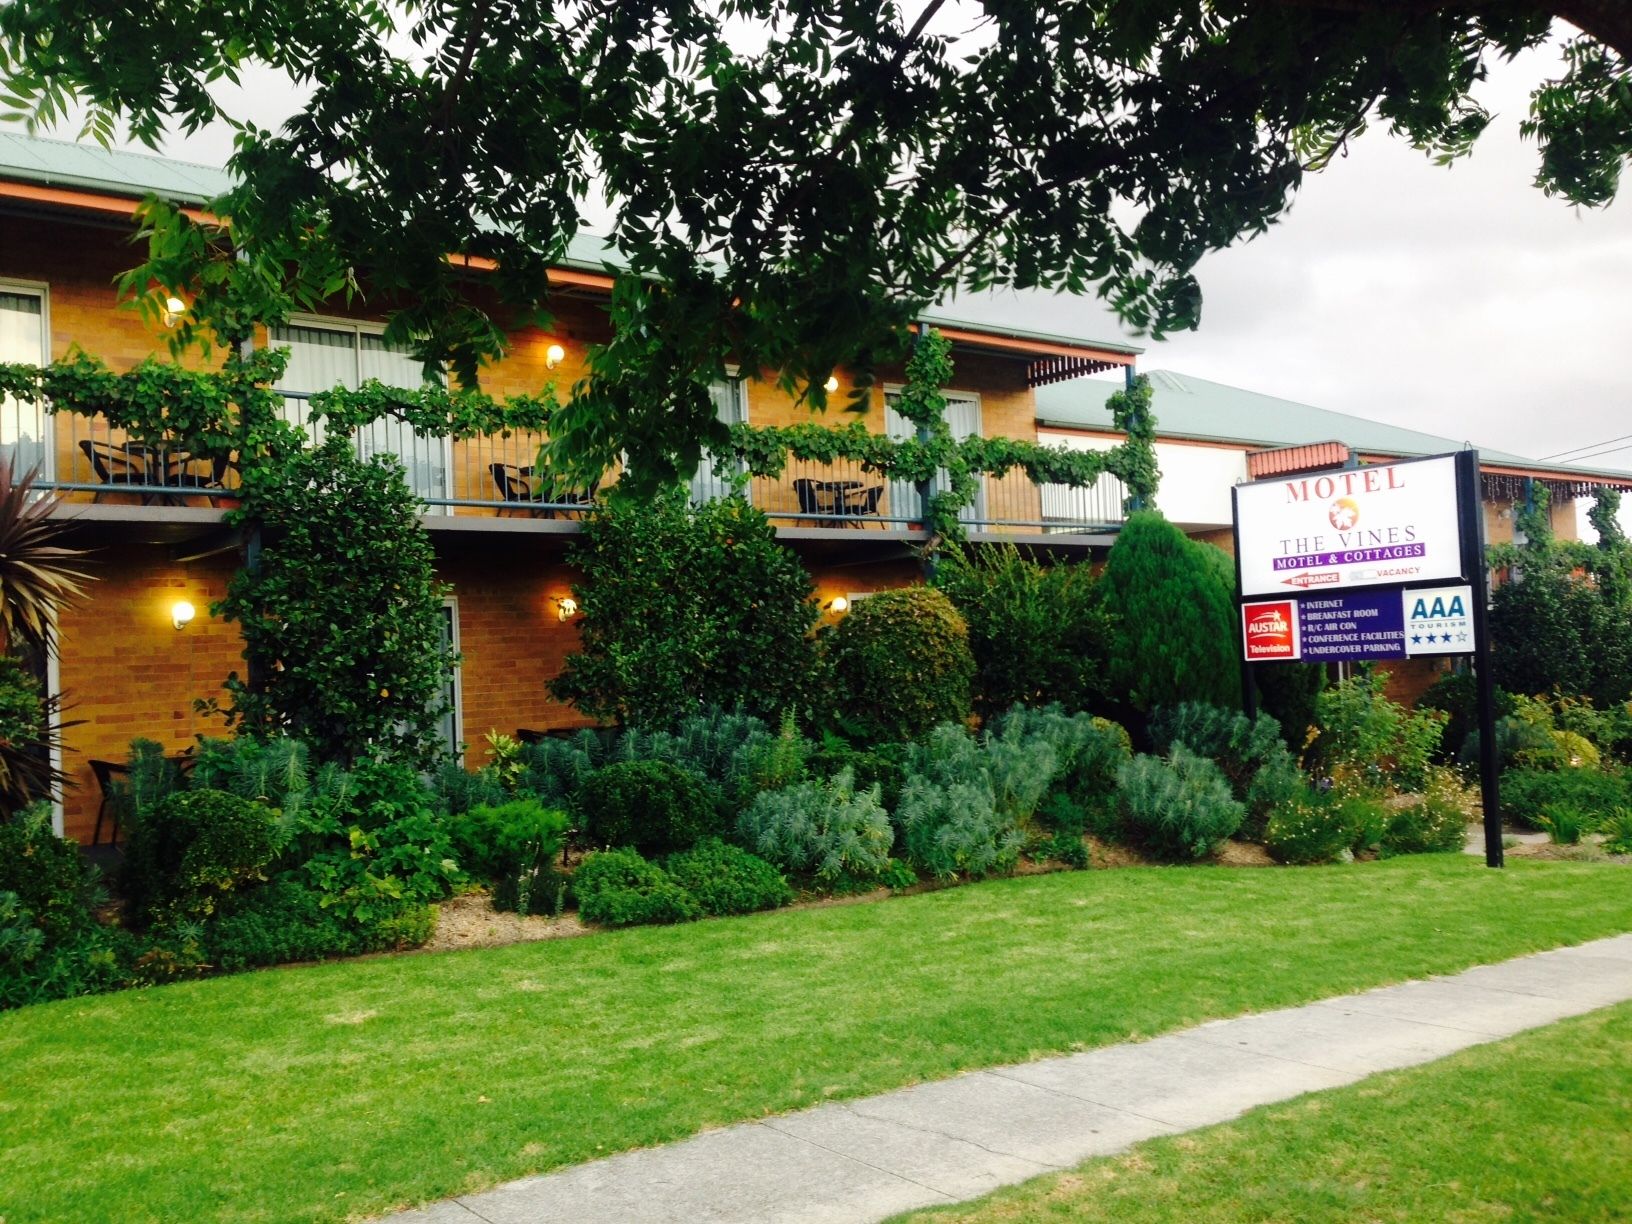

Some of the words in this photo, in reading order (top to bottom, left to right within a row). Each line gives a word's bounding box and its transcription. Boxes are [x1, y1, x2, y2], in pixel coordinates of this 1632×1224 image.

[1285, 467, 1405, 503] MOTEL
[1280, 536, 1325, 554] THE
[1339, 525, 1416, 548] VINES
[1277, 556, 1323, 569] MOTEL
[1328, 553, 1338, 564] &
[1344, 545, 1422, 562] COTTAGES
[1376, 566, 1420, 577] VACANCY
[1291, 573, 1338, 585] ENTRANCE
[1306, 600, 1343, 609] INTERNET
[1411, 595, 1465, 619] AAA
[1307, 610, 1351, 620] BREAKFAST
[1353, 608, 1378, 618] ROOM
[1248, 621, 1288, 633] AUSTAR
[1324, 622, 1338, 631] AIR
[1339, 622, 1357, 630] CON
[1410, 621, 1466, 629] TOURISM
[1308, 633, 1359, 643] CONFERENCE
[1361, 631, 1404, 641] FACILITIES
[1249, 643, 1290, 653] Television
[1309, 644, 1361, 654] UNDERCOVER
[1363, 643, 1400, 652] PARKING
